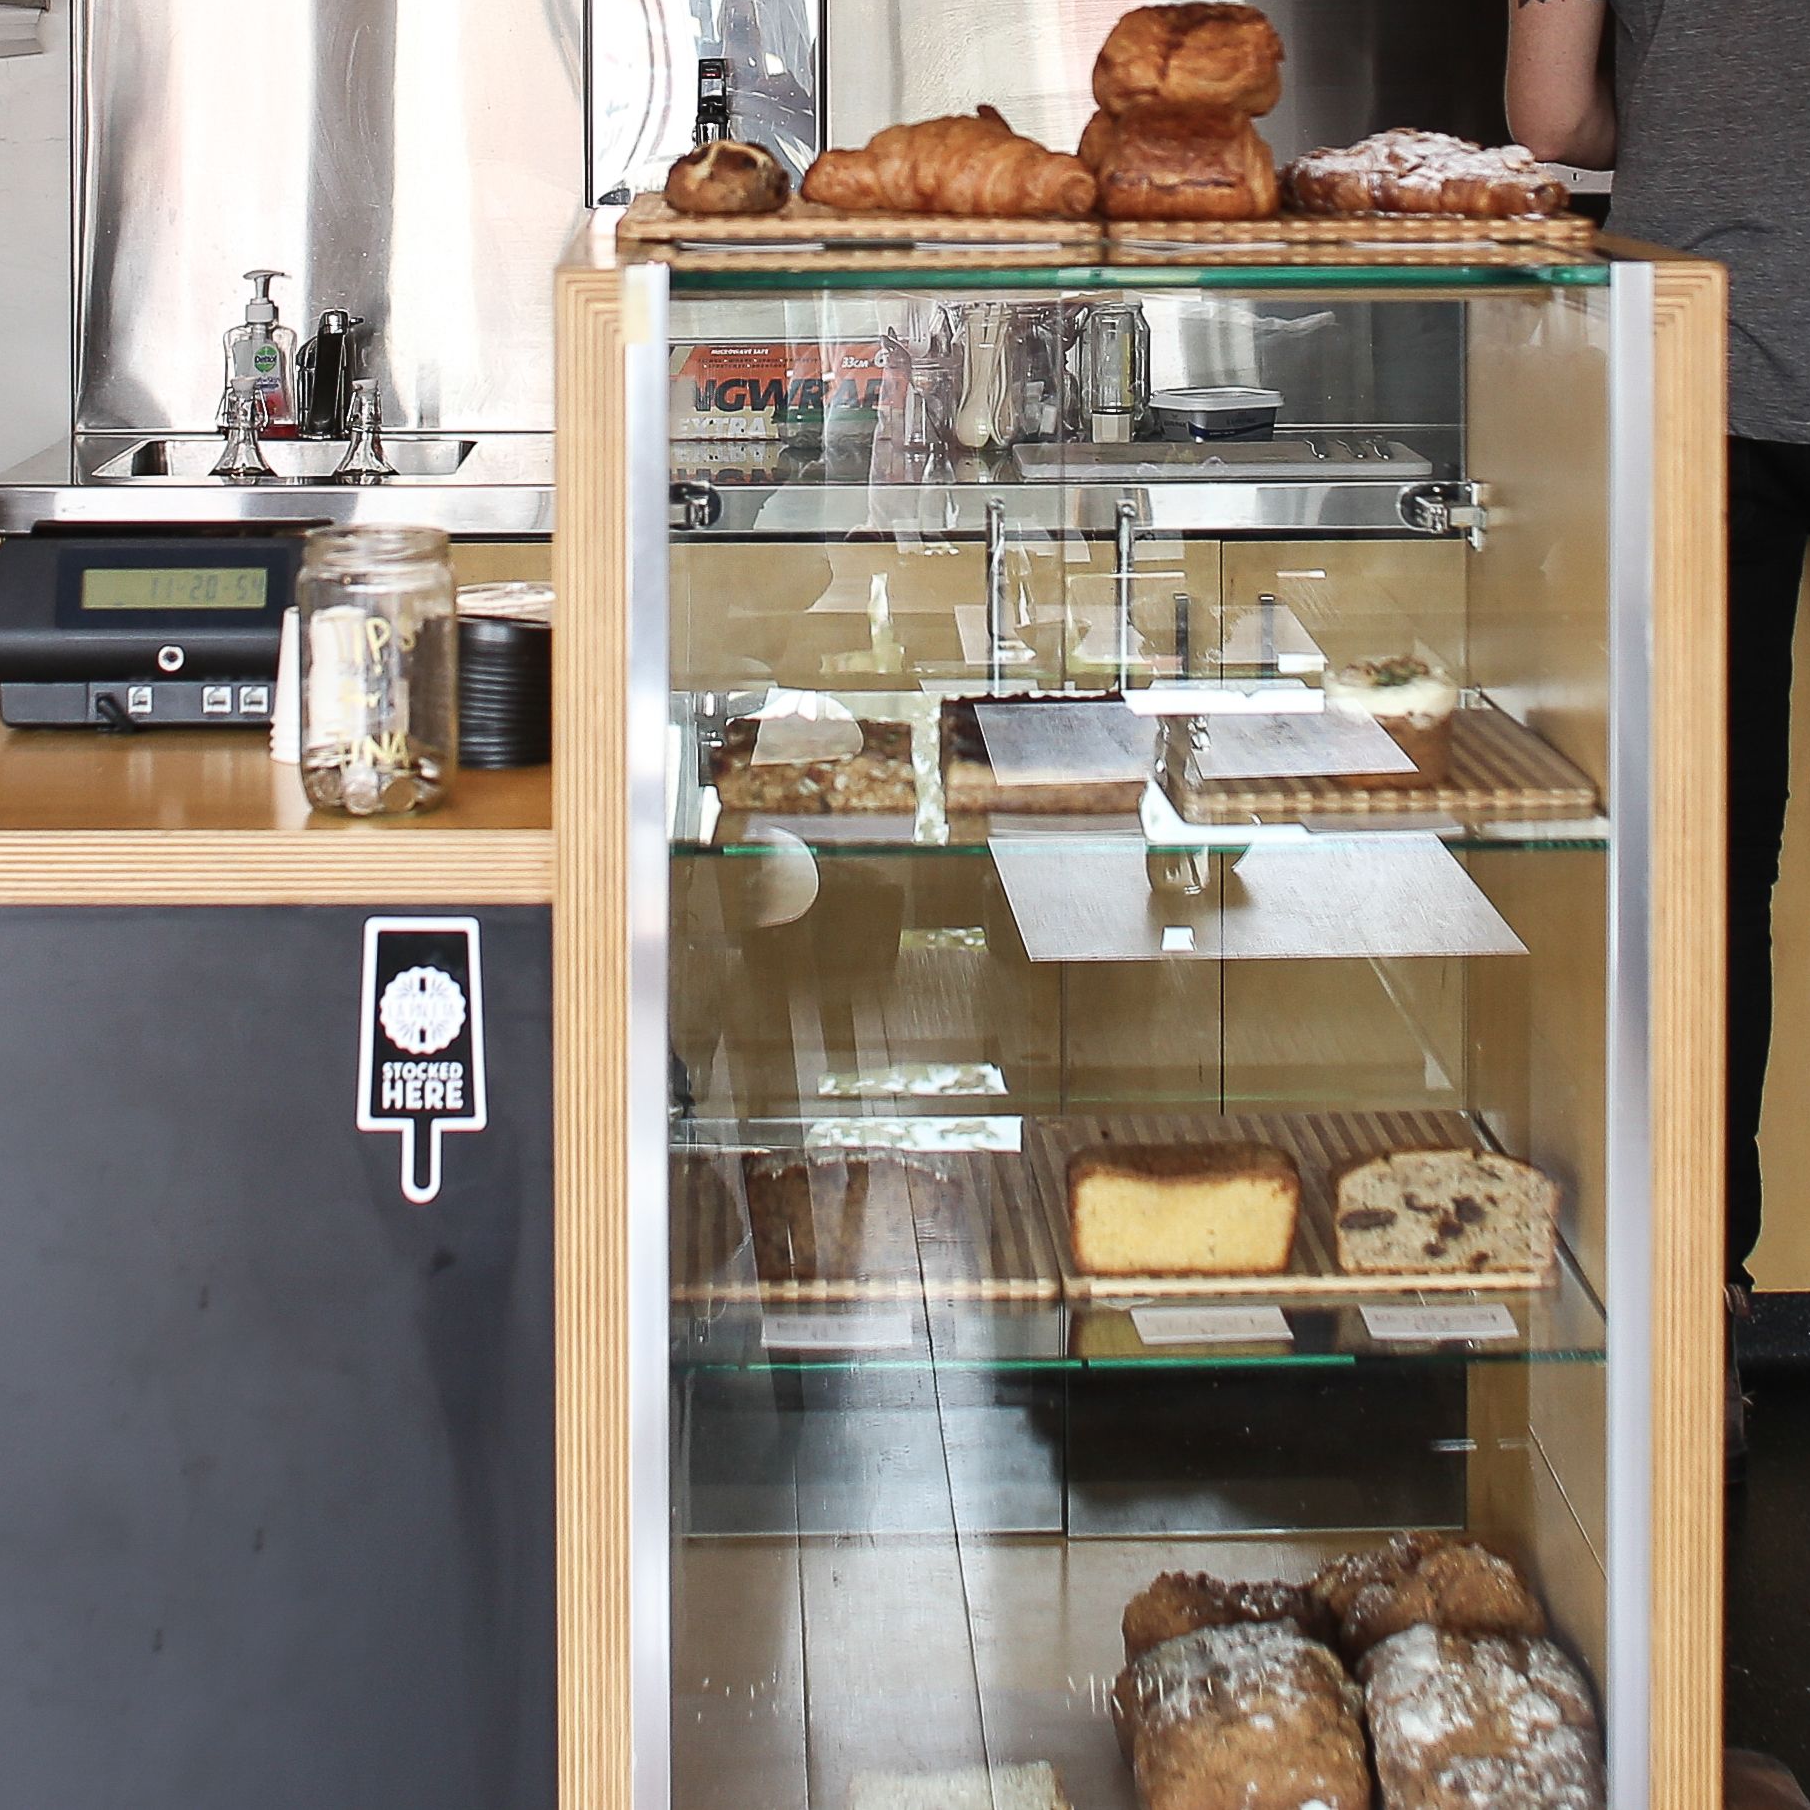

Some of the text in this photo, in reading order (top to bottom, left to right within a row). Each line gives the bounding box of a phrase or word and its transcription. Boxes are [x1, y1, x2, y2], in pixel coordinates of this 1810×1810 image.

[693, 378, 891, 413] NGWRAP
[679, 417, 768, 437] EXTRA
[382, 1061, 464, 1081] STOCKED
[382, 1079, 464, 1110] HERE
